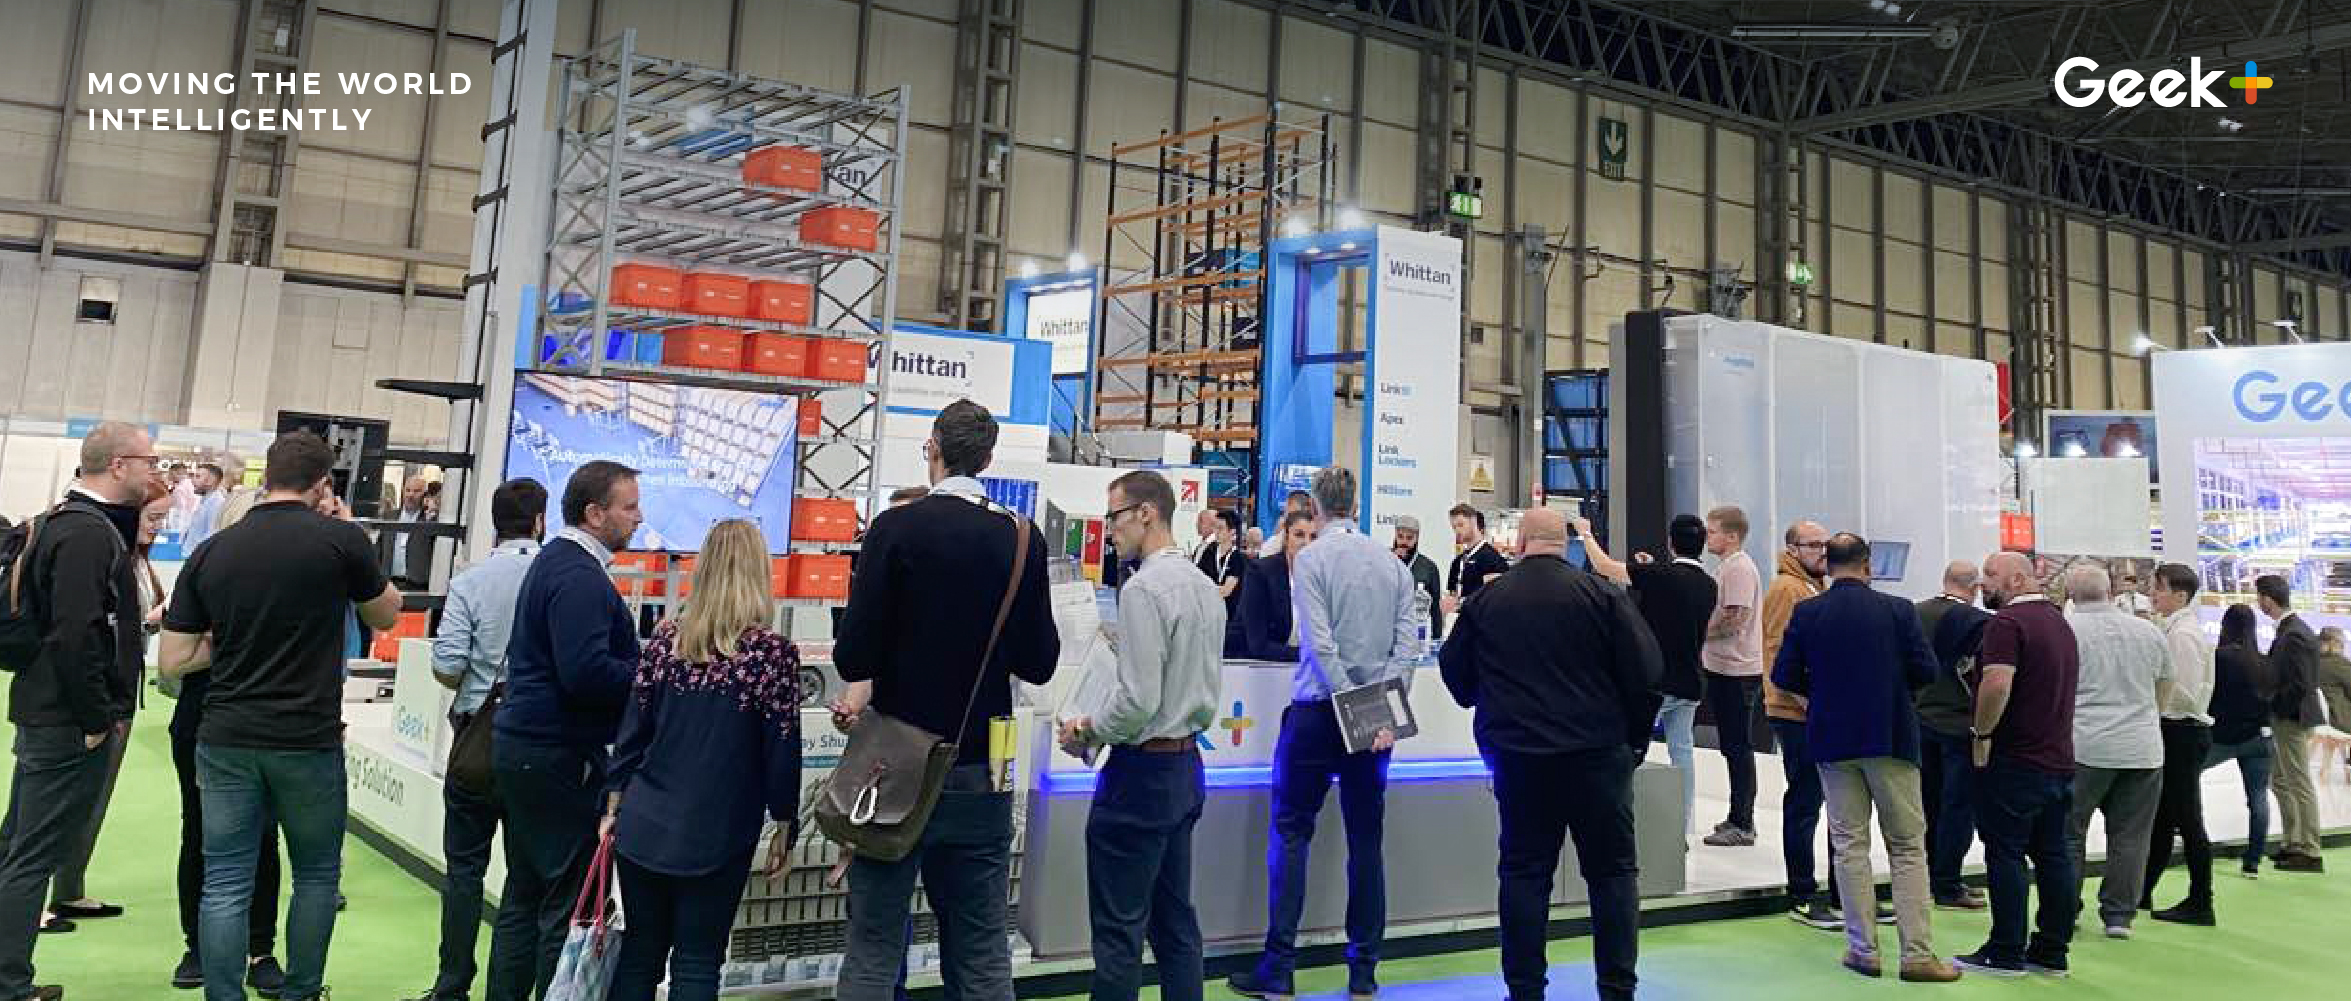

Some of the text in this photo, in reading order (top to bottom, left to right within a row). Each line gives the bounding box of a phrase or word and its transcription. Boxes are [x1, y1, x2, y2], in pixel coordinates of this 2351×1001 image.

[1389, 259, 1451, 285] Whittan
[1040, 318, 1088, 337] Whittan
[2233, 370, 2351, 422] Ge
[362, 756, 404, 806] Solution
